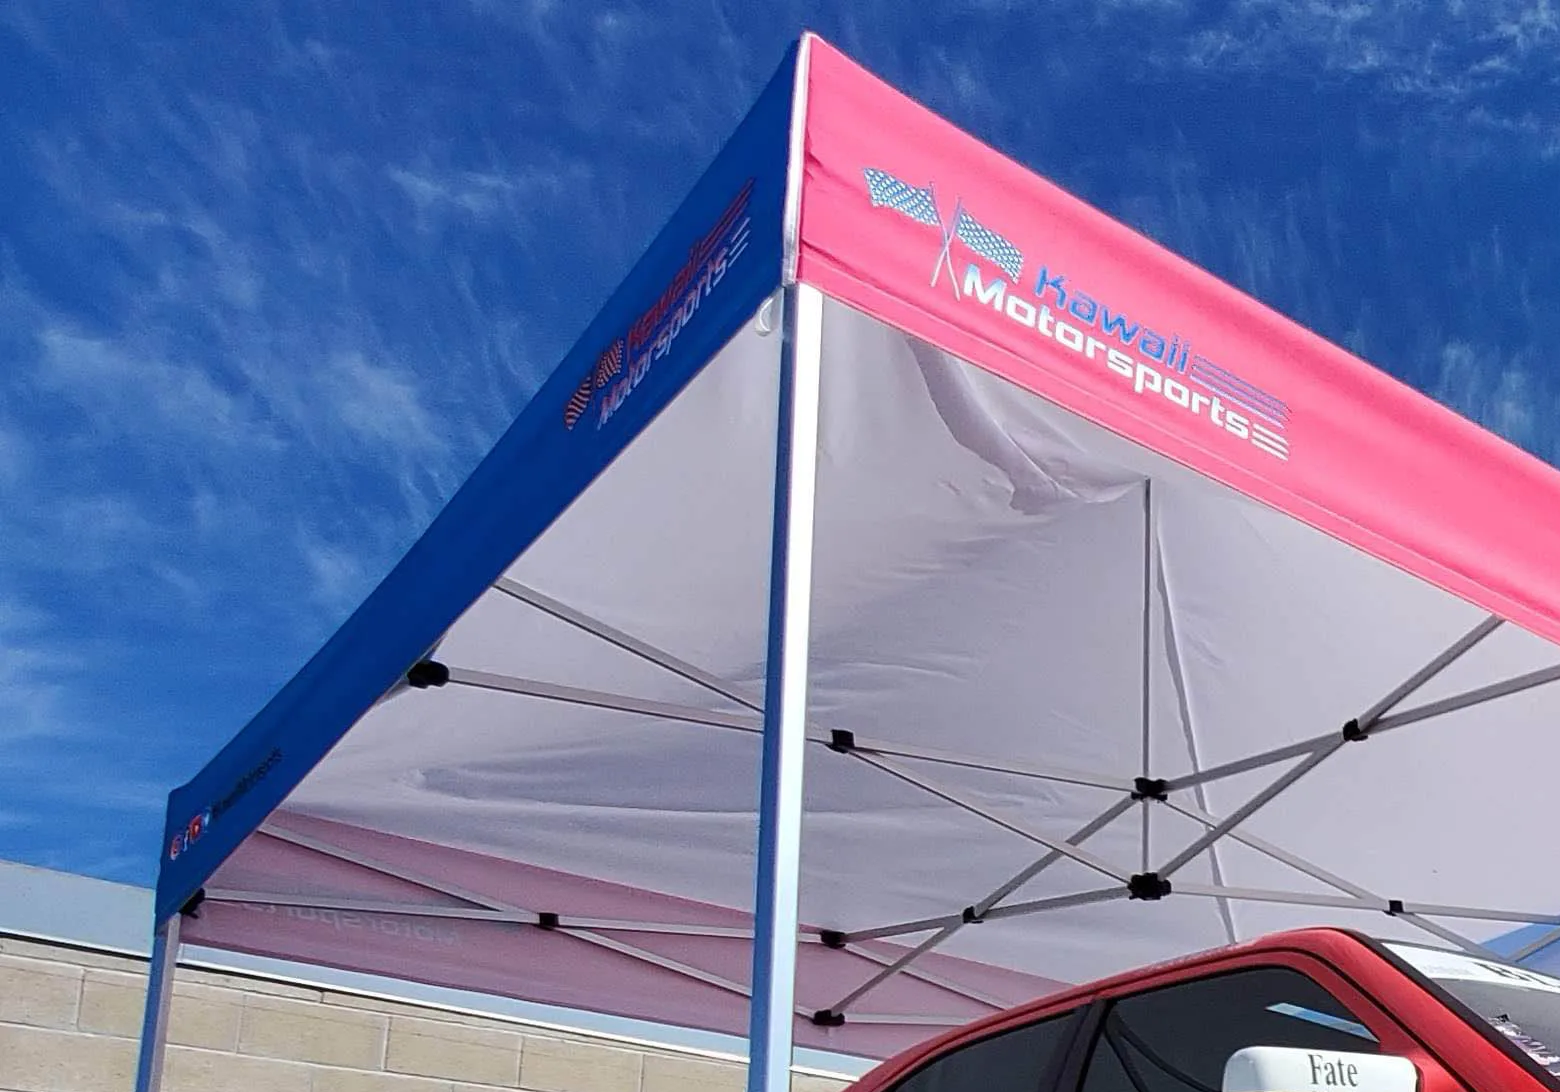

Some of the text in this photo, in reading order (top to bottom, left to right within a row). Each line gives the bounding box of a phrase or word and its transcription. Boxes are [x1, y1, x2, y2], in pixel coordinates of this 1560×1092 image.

[963, 264, 1249, 440] Motorsports
[1035, 265, 1191, 374] Kawaii
[1308, 1053, 1358, 1087] Fate
